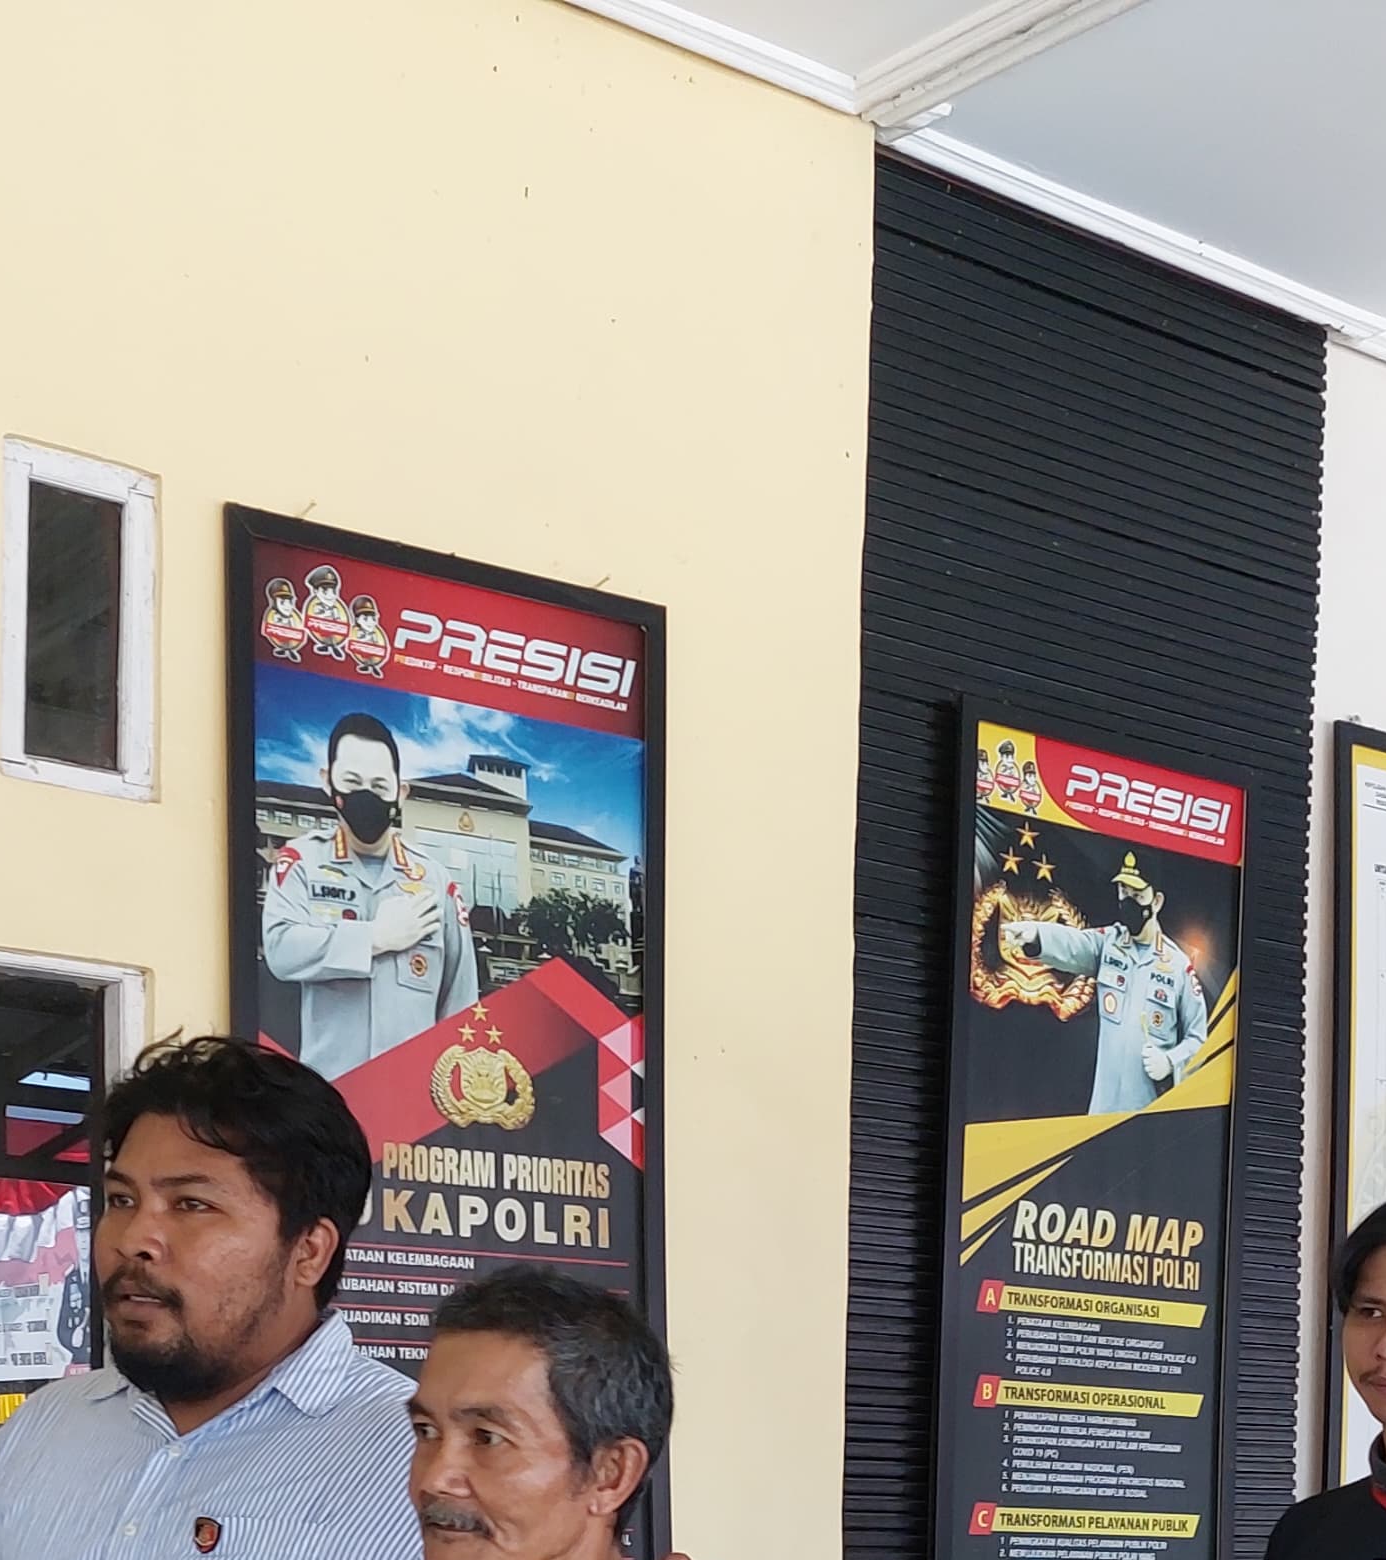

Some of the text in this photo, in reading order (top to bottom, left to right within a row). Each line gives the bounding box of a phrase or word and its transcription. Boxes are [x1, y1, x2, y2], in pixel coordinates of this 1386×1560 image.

[394, 609, 637, 698] PRESISI
[1065, 765, 1232, 834] PRESISI
[382, 1142, 611, 1200] PROGRAM PRIORITAS
[382, 1187, 611, 1249] KAPOLRI
[1013, 1199, 1204, 1258] ROAD MAP
[345, 1249, 475, 1270] ATAAN KELEMBAGAAN
[1012, 1241, 1200, 1291] TRANSFORMASI POLRI
[397, 1281, 438, 1296] SISTEM
[984, 1287, 1160, 1319] A TRANSFORMASI ORGANISASI
[403, 1313, 430, 1326] SDM
[397, 1347, 429, 1360] TEKN
[982, 1382, 1166, 1410] B TRANSFORMASI OPERASIONAL
[977, 1509, 1189, 1533] C TRANSFORMASI PELAYANAN PUBLIK
